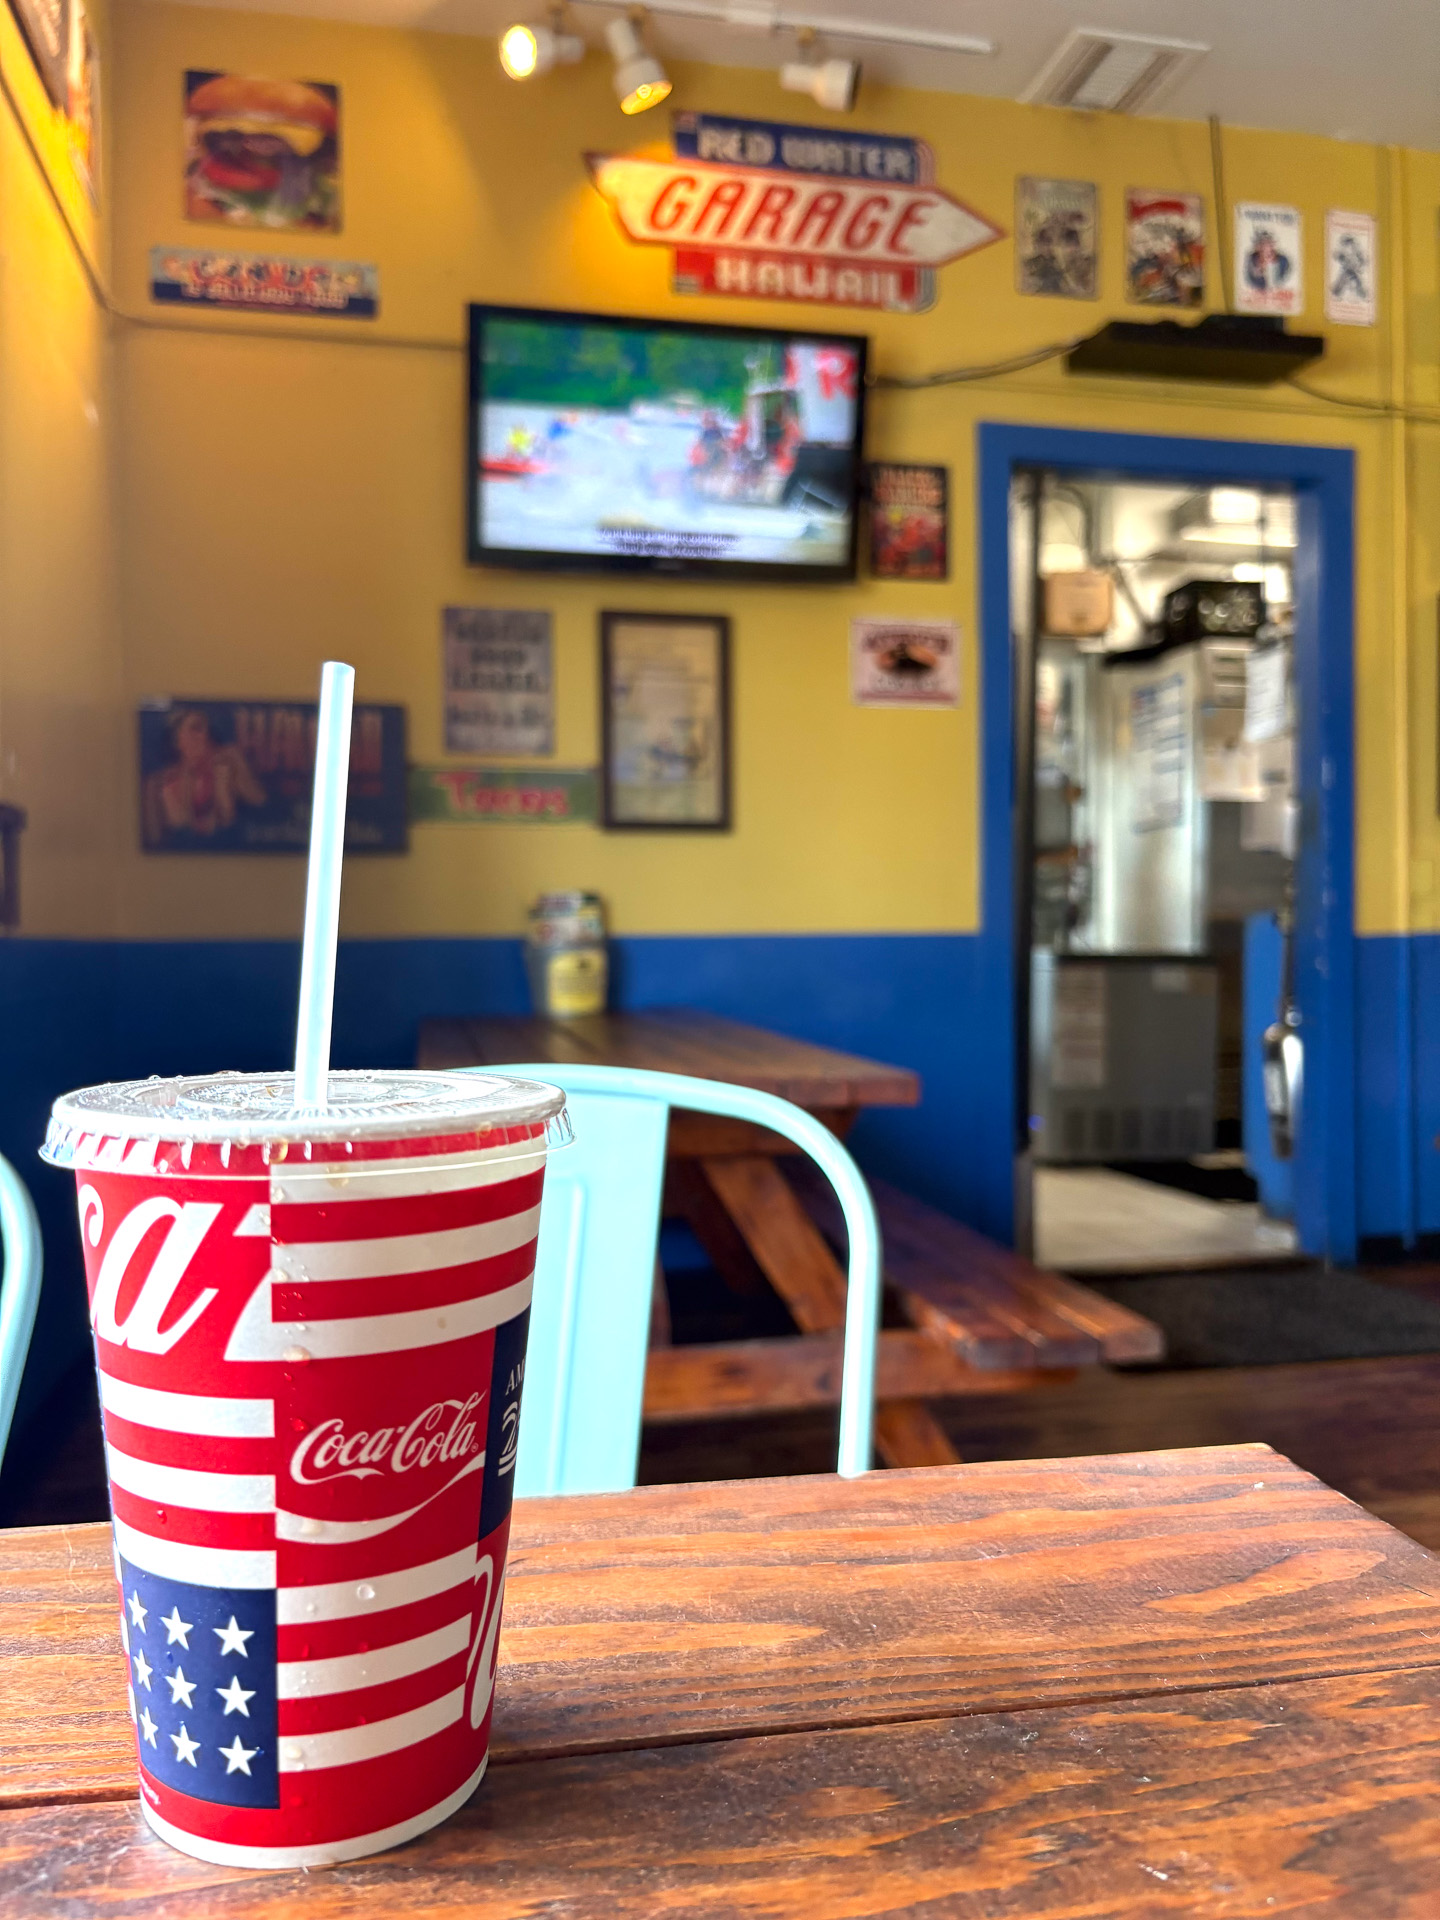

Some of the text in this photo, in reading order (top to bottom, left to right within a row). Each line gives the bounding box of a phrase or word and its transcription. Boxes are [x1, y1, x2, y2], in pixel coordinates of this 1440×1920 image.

[698, 127, 913, 180] RED WATER
[648, 173, 940, 256] GARAGE
[713, 255, 900, 303] HAWAII
[289, 1389, 487, 1486] Coca-Cola
